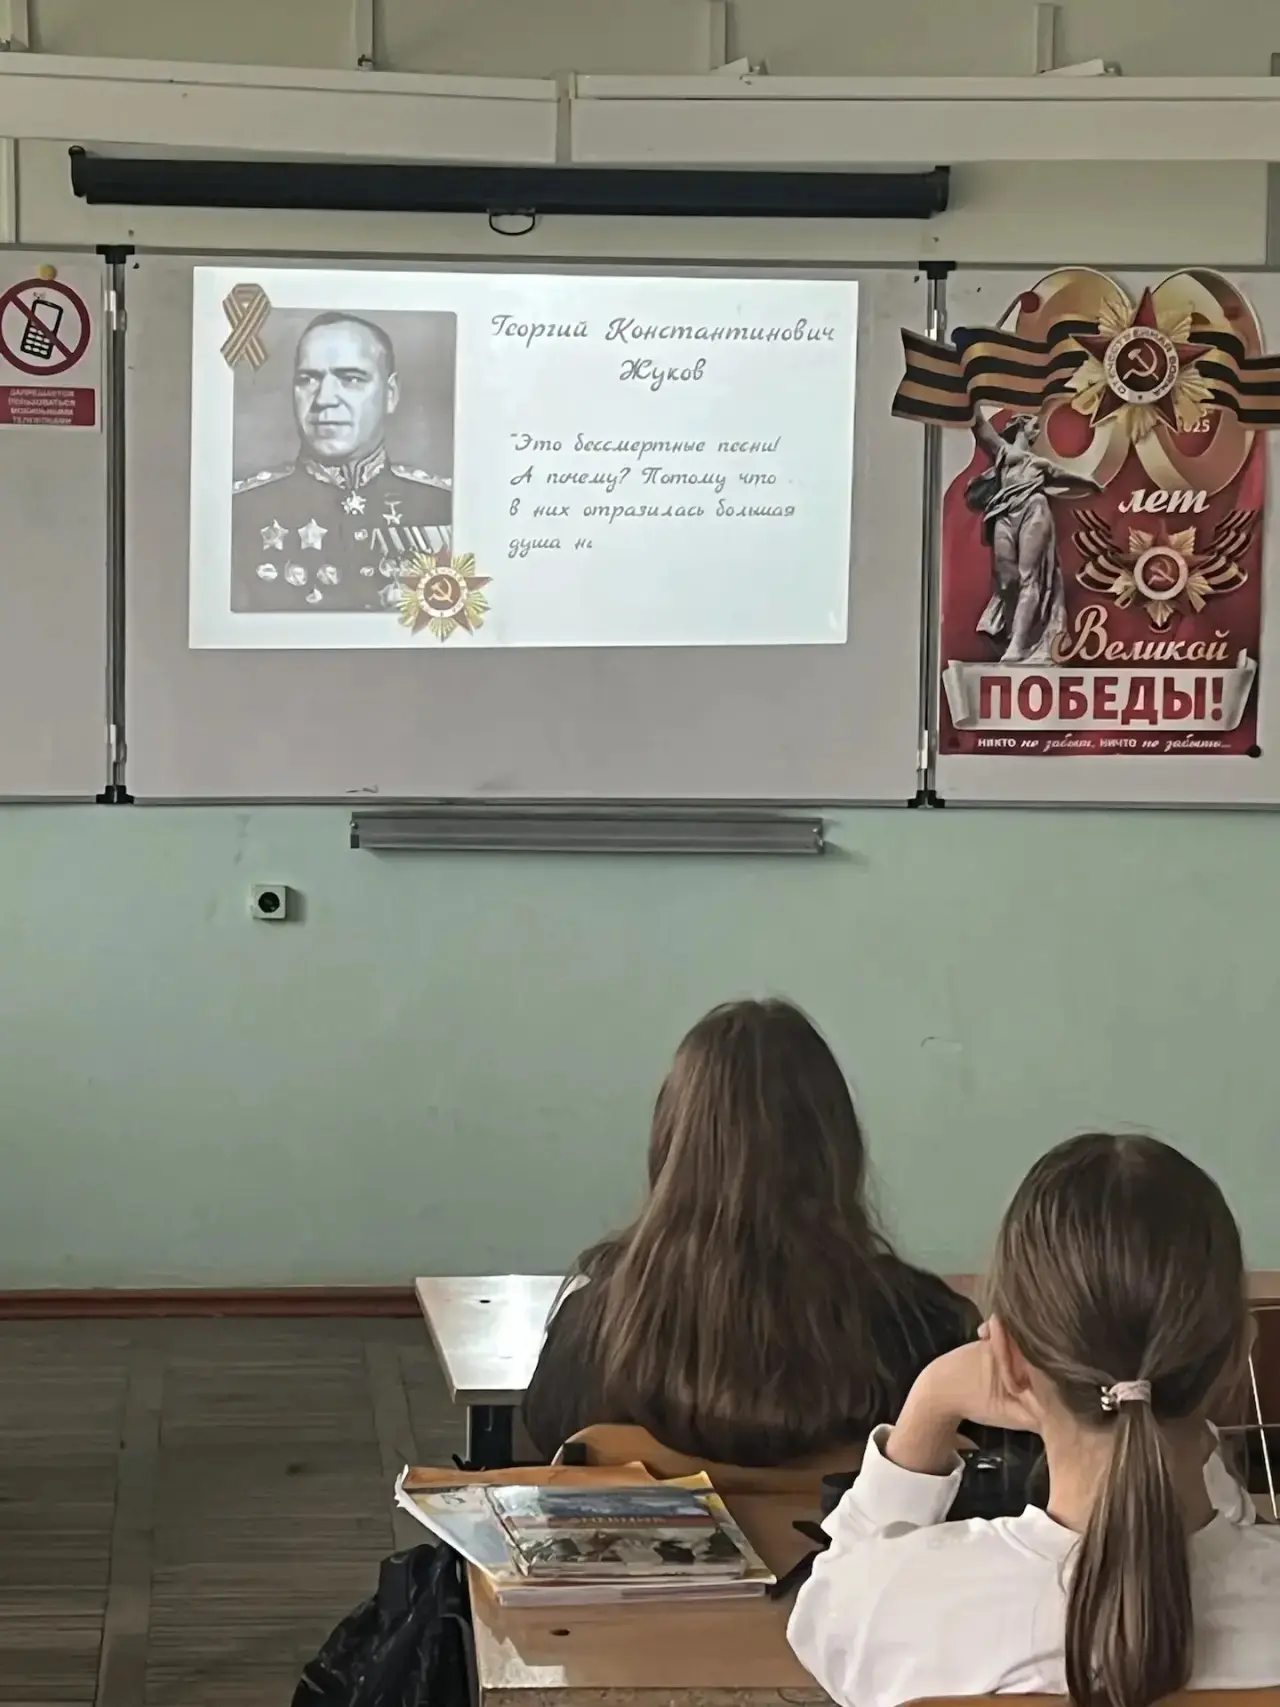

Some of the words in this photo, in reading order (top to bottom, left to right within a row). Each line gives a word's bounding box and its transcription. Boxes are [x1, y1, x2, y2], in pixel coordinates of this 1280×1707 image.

[491, 313, 589, 349] Георгий
[604, 316, 836, 345] Константинович
[618, 357, 707, 393] Жуков
[573, 432, 707, 461] бессмертные
[716, 435, 782, 454] песни!
[509, 464, 535, 487] А
[546, 466, 632, 494] почему?
[640, 466, 727, 495] Потому
[738, 472, 777, 487] что
[509, 497, 521, 517] в
[532, 505, 571, 518] них
[582, 505, 705, 525] отразилась
[715, 497, 796, 518] большая
[1119, 488, 1211, 515] лет
[507, 537, 562, 560] душа
[1051, 604, 1231, 664] Великой
[979, 675, 1225, 726] ПОБЕДЫ!
[977, 738, 1016, 748] НИКТО
[1099, 738, 1137, 748] НИЧТО
